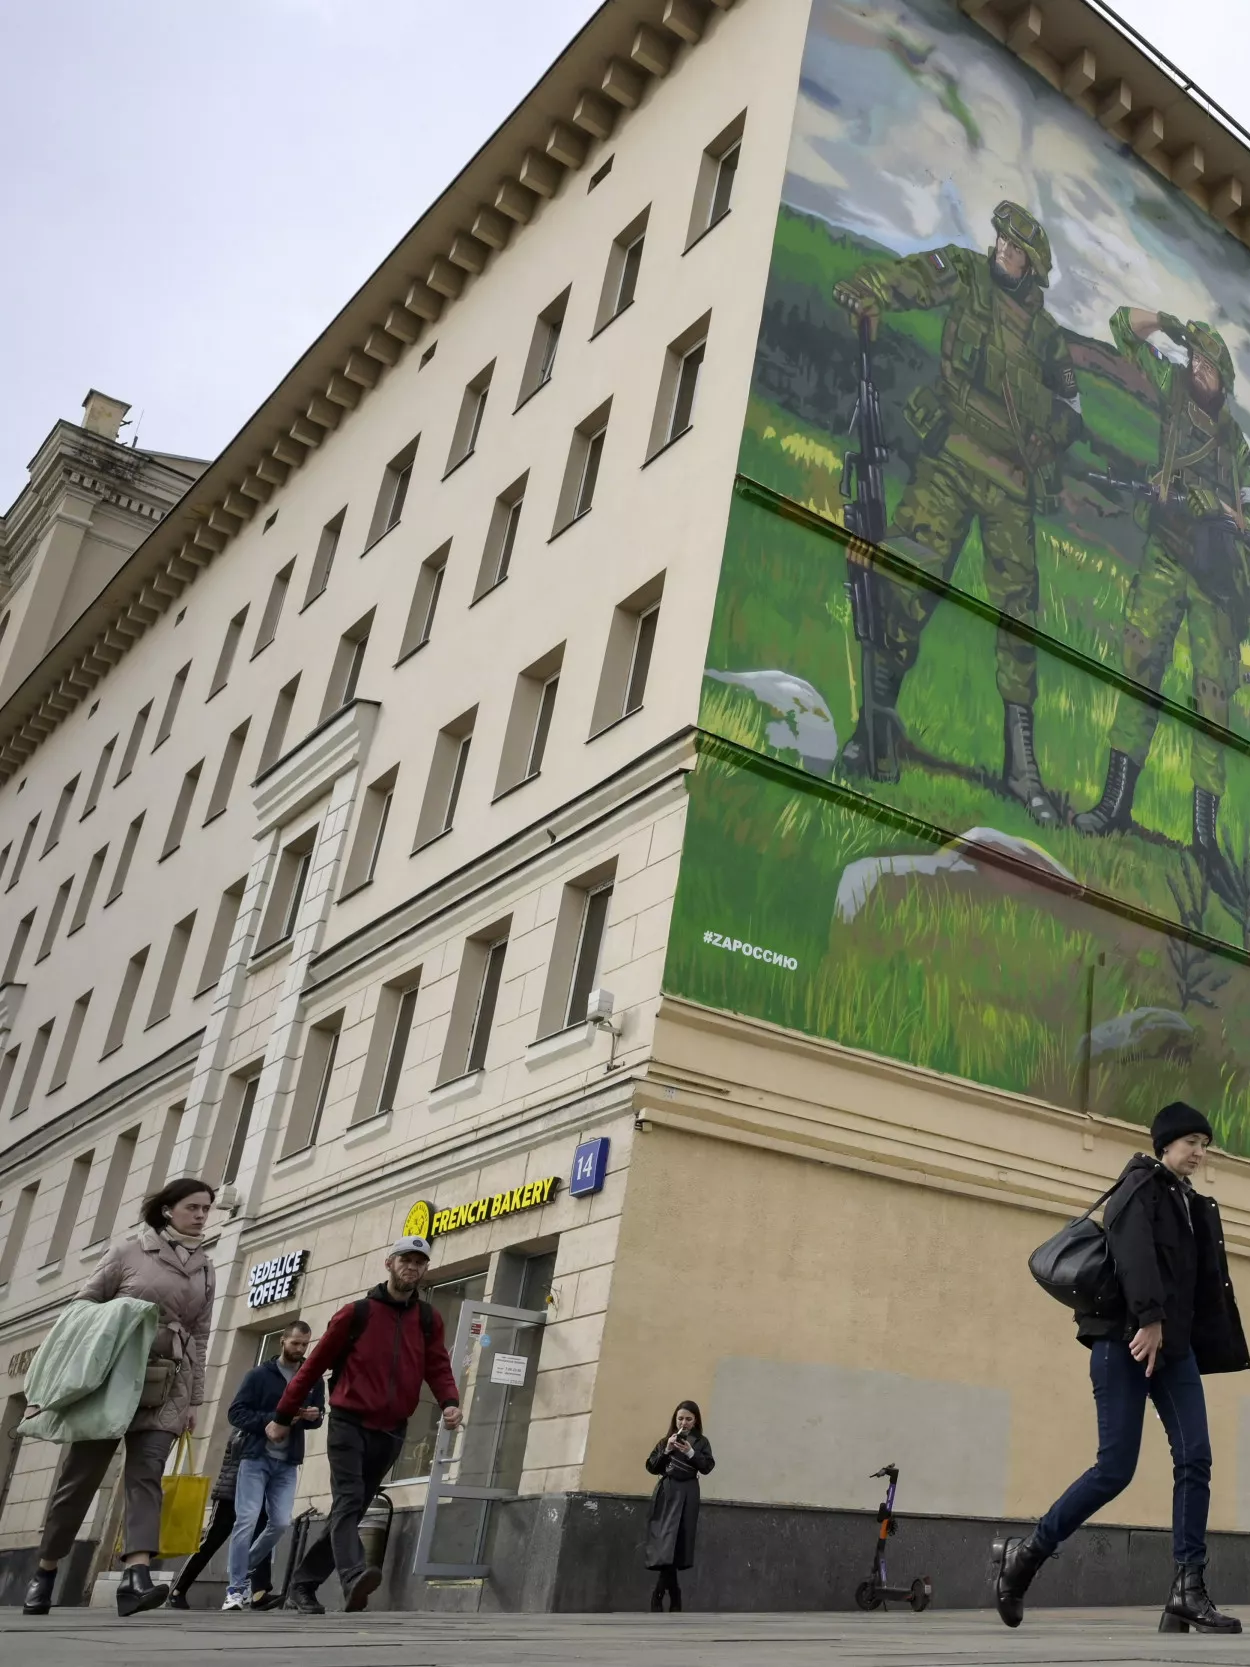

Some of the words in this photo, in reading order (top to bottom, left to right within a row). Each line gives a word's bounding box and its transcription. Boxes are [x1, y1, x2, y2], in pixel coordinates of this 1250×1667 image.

[577, 1152, 594, 1181] 14
[431, 1197, 490, 1236] FRENCH
[491, 1176, 554, 1217] BAKERY
[248, 1249, 303, 1287] SEDELICE
[247, 1275, 293, 1308] COFFEE
